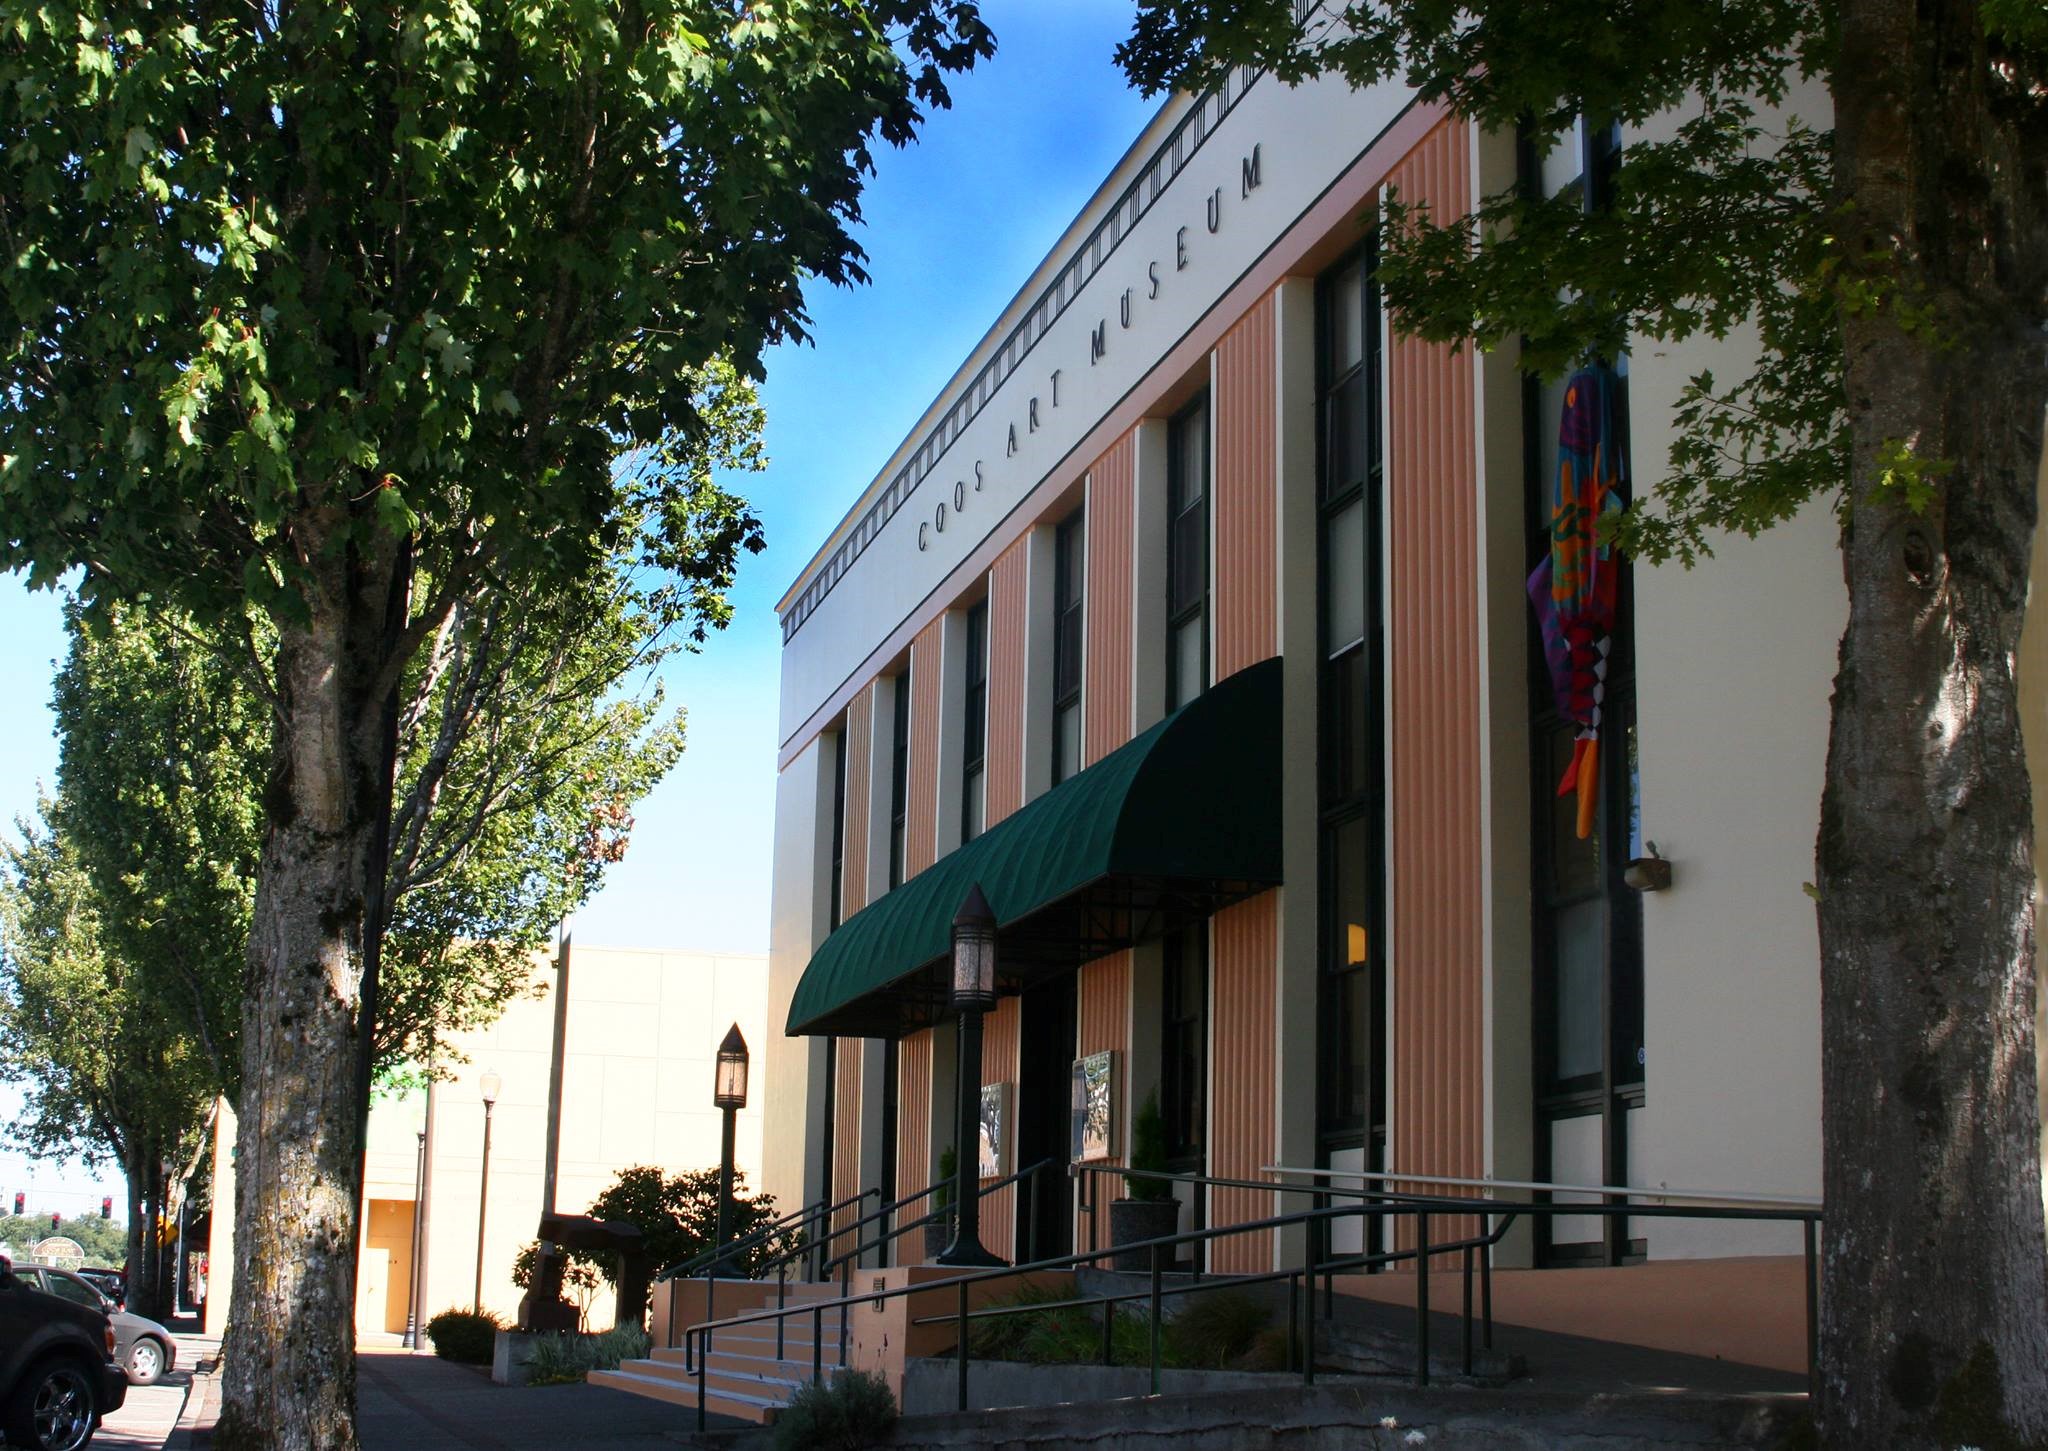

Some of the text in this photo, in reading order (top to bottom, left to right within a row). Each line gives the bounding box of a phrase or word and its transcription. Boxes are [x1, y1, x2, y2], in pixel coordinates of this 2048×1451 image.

[918, 142, 1262, 552] COOS ART MUSEUM
